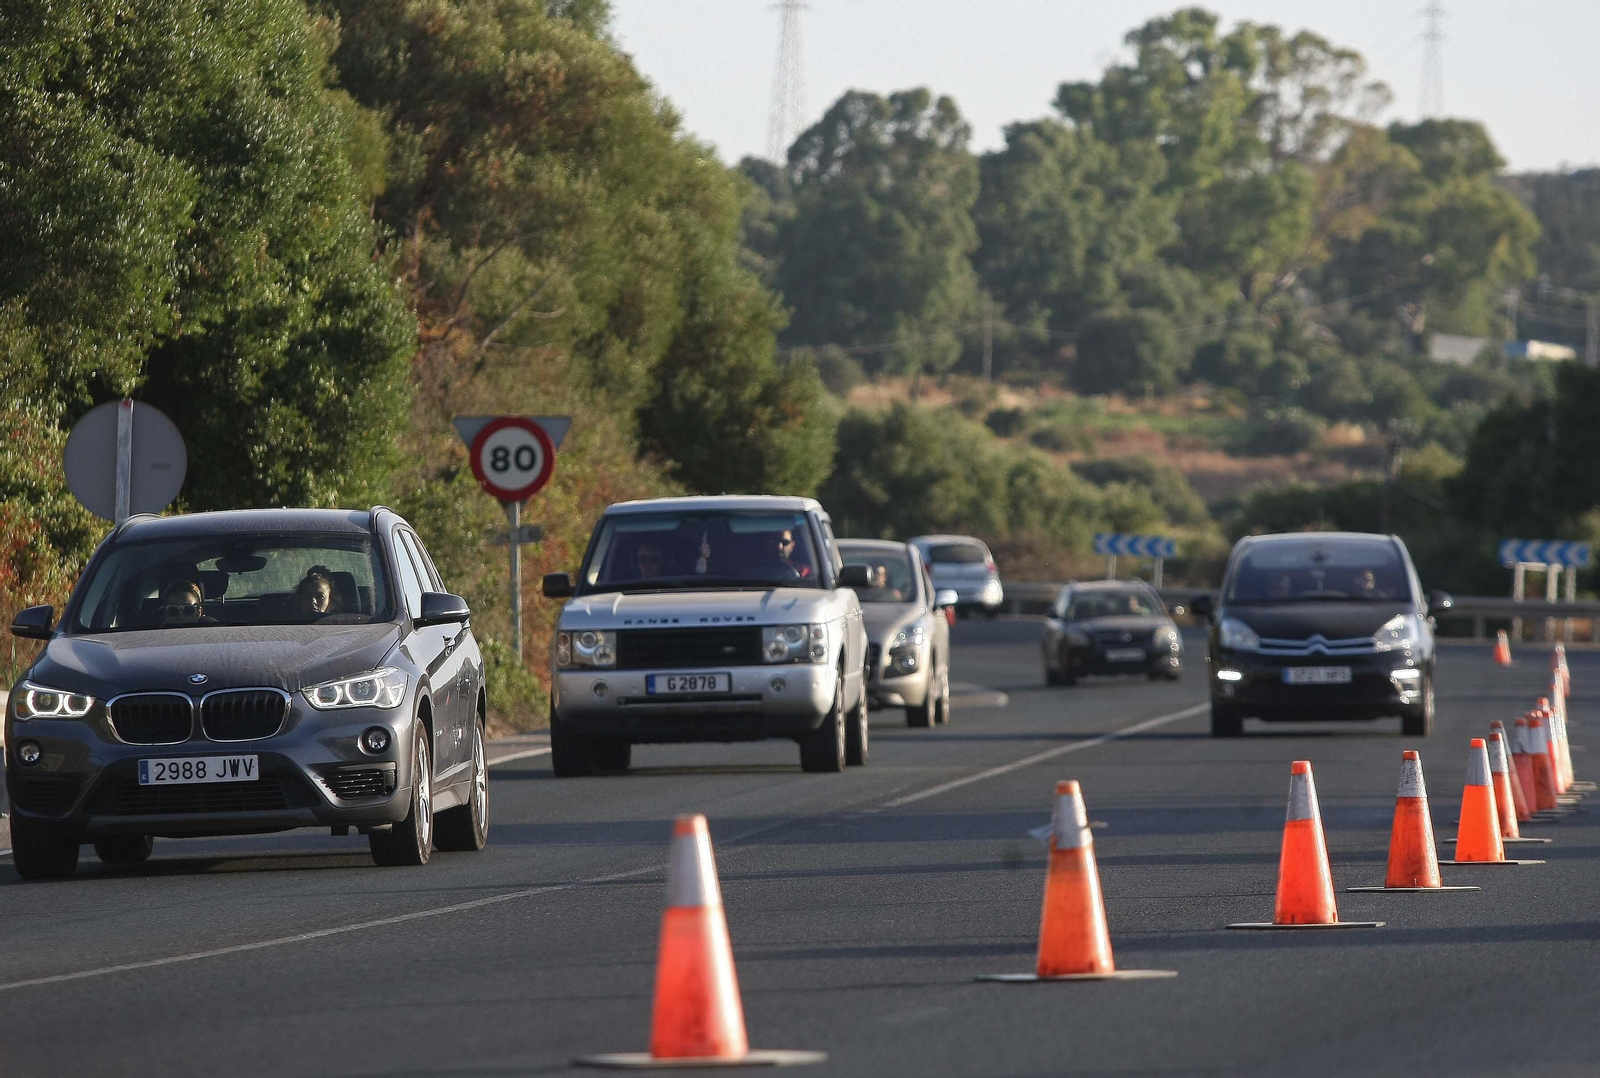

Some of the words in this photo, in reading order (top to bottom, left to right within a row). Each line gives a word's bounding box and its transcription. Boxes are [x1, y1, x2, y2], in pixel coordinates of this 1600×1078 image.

[491, 445, 537, 472] 80
[154, 761, 207, 781] 2988
[215, 758, 253, 778] JWV
